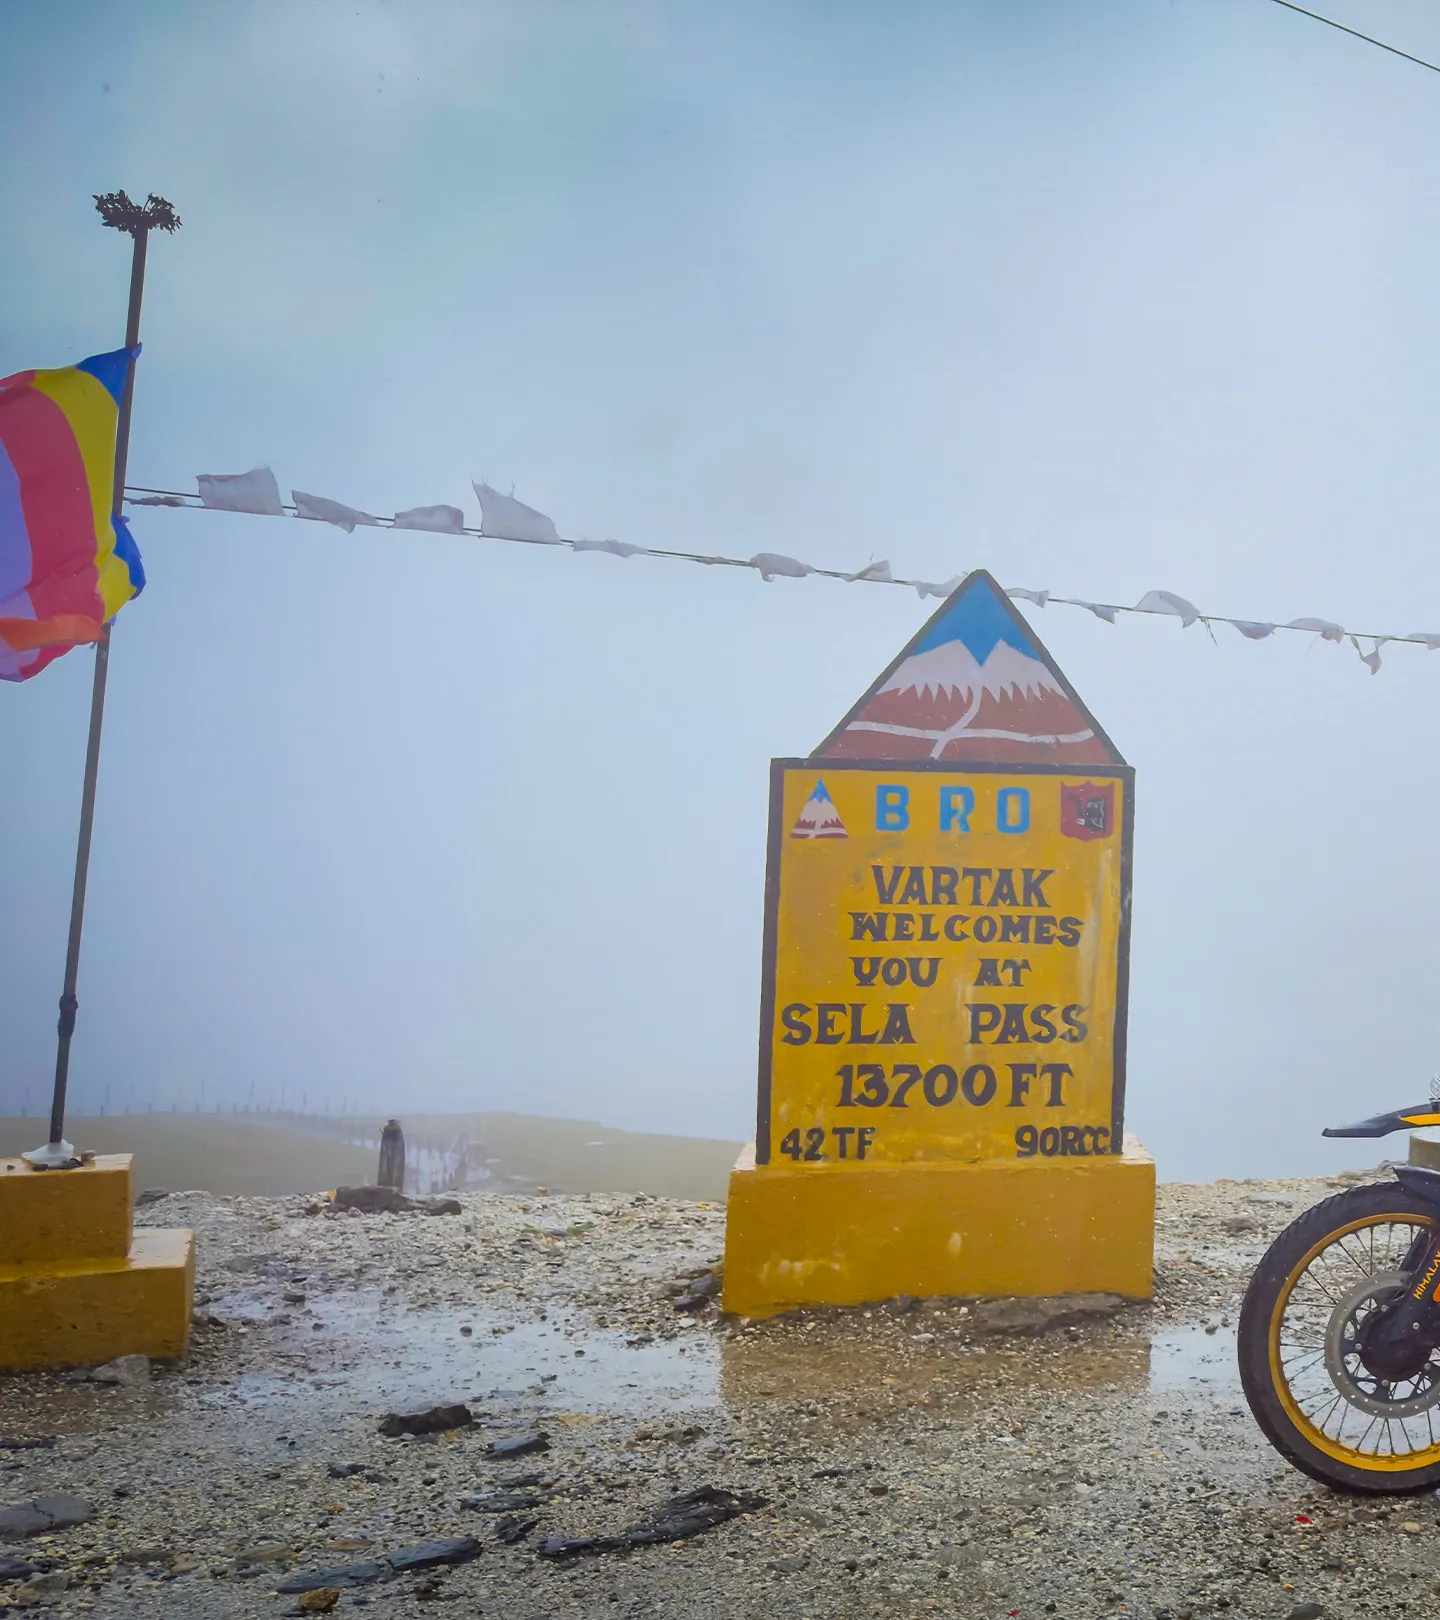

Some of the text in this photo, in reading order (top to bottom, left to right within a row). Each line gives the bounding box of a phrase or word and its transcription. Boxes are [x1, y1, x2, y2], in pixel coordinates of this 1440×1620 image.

[872, 865, 1056, 908] VARTAK
[848, 912, 1086, 947] WELCOMES
[848, 956, 1033, 988] YOU AT
[781, 1003, 1092, 1046] SELA PASS
[836, 1064, 1074, 1108] 13700 FT
